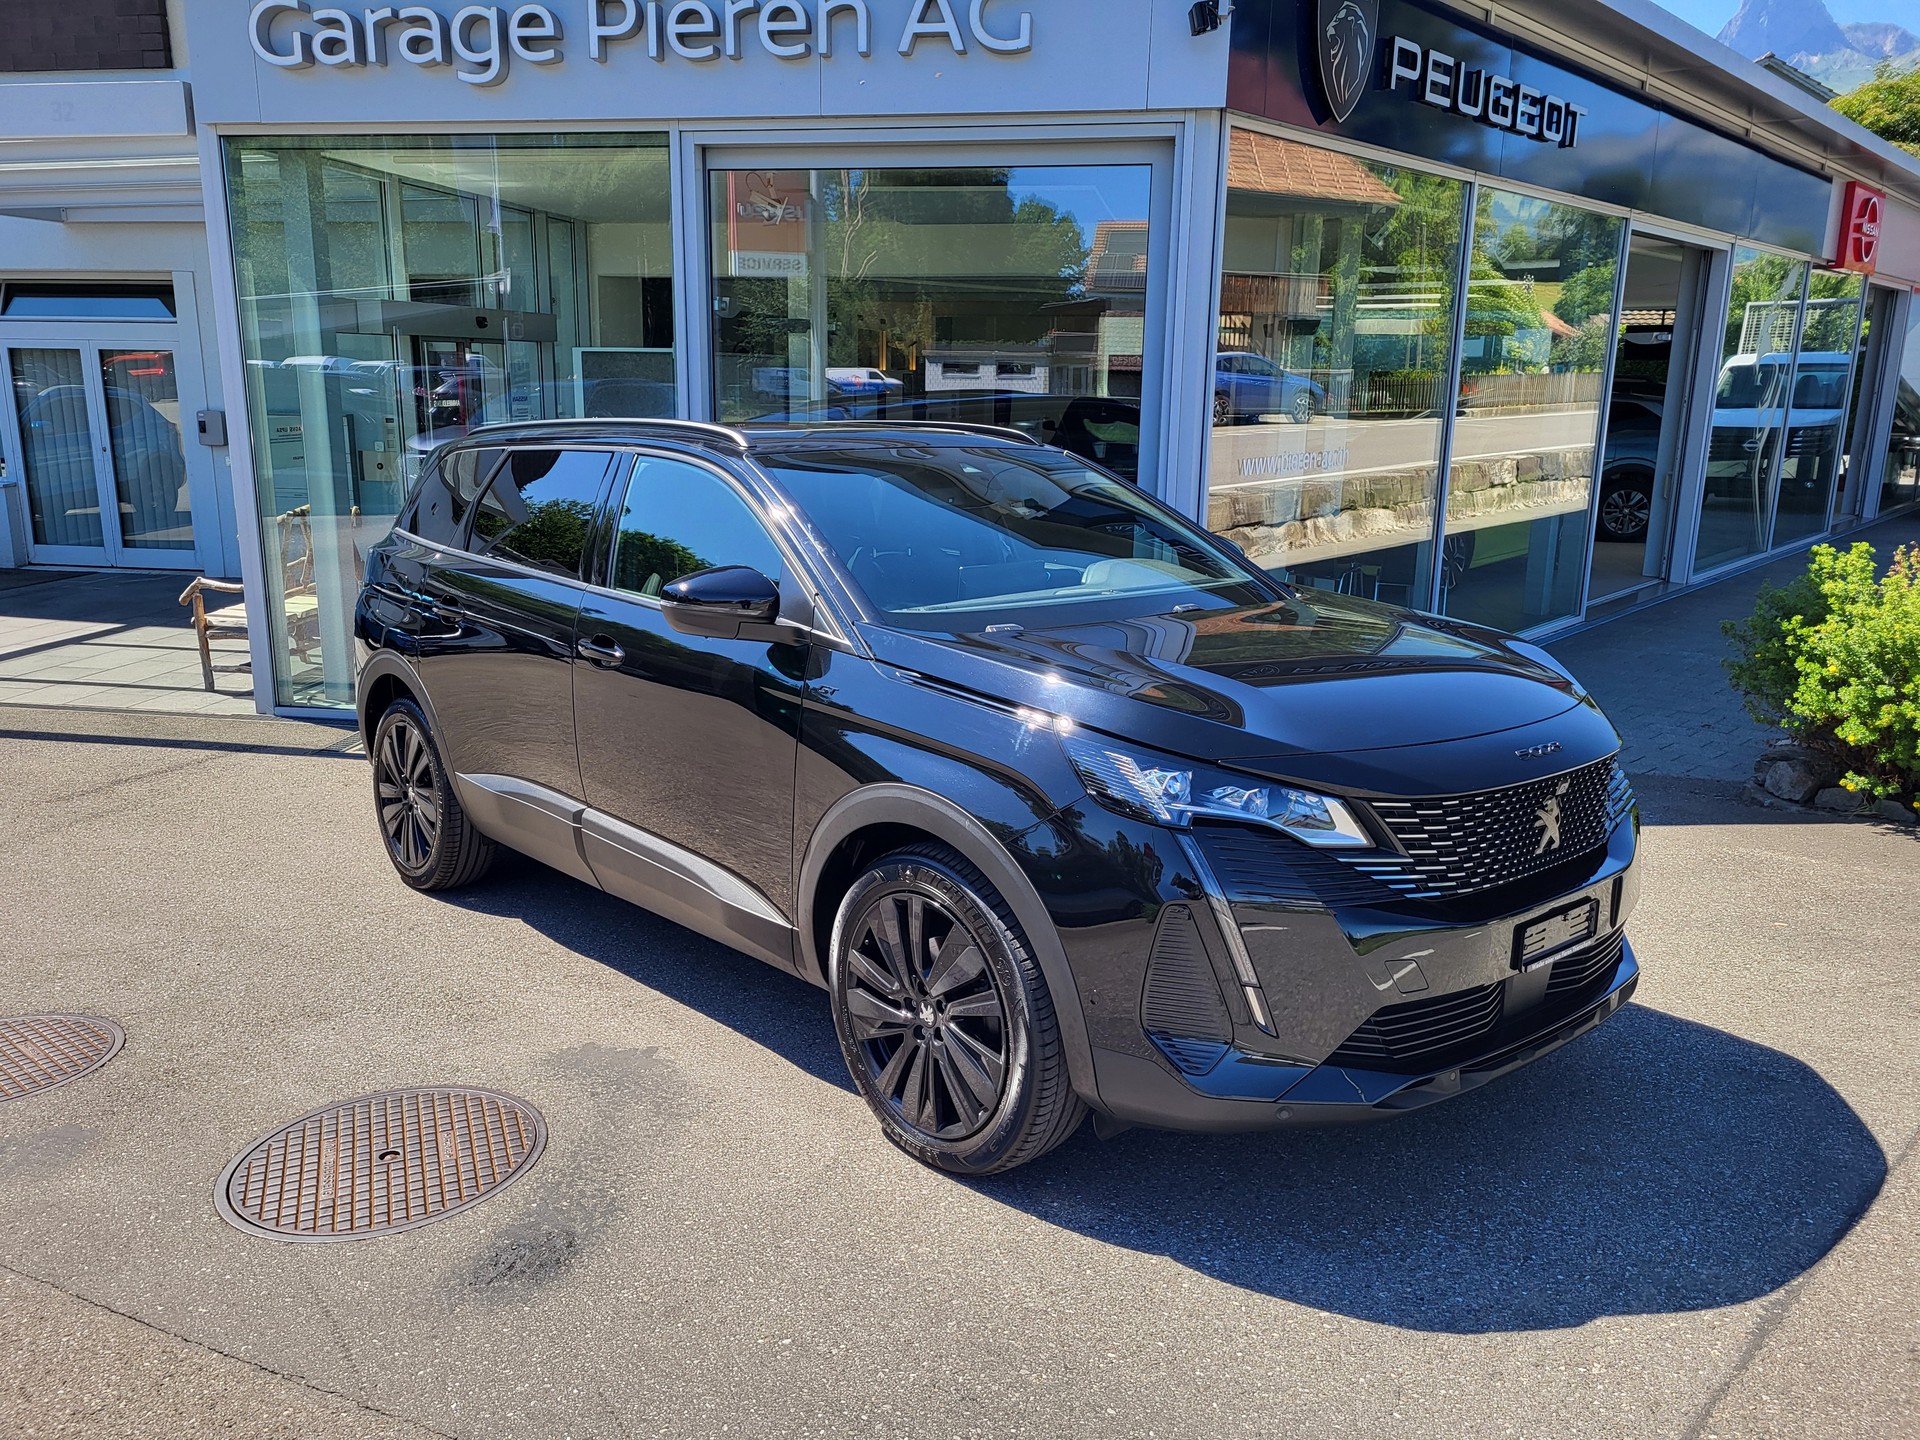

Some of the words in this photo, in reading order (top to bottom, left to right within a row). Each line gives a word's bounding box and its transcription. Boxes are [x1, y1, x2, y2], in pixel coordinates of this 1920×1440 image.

[248, 0, 562, 86] Garage
[588, 0, 871, 62] Pieren
[897, 0, 1032, 55] AG
[1388, 35, 1588, 148] PEUGEOT
[1861, 222, 1880, 237] NISSAN
[915, 865, 994, 946] MICHELIN
